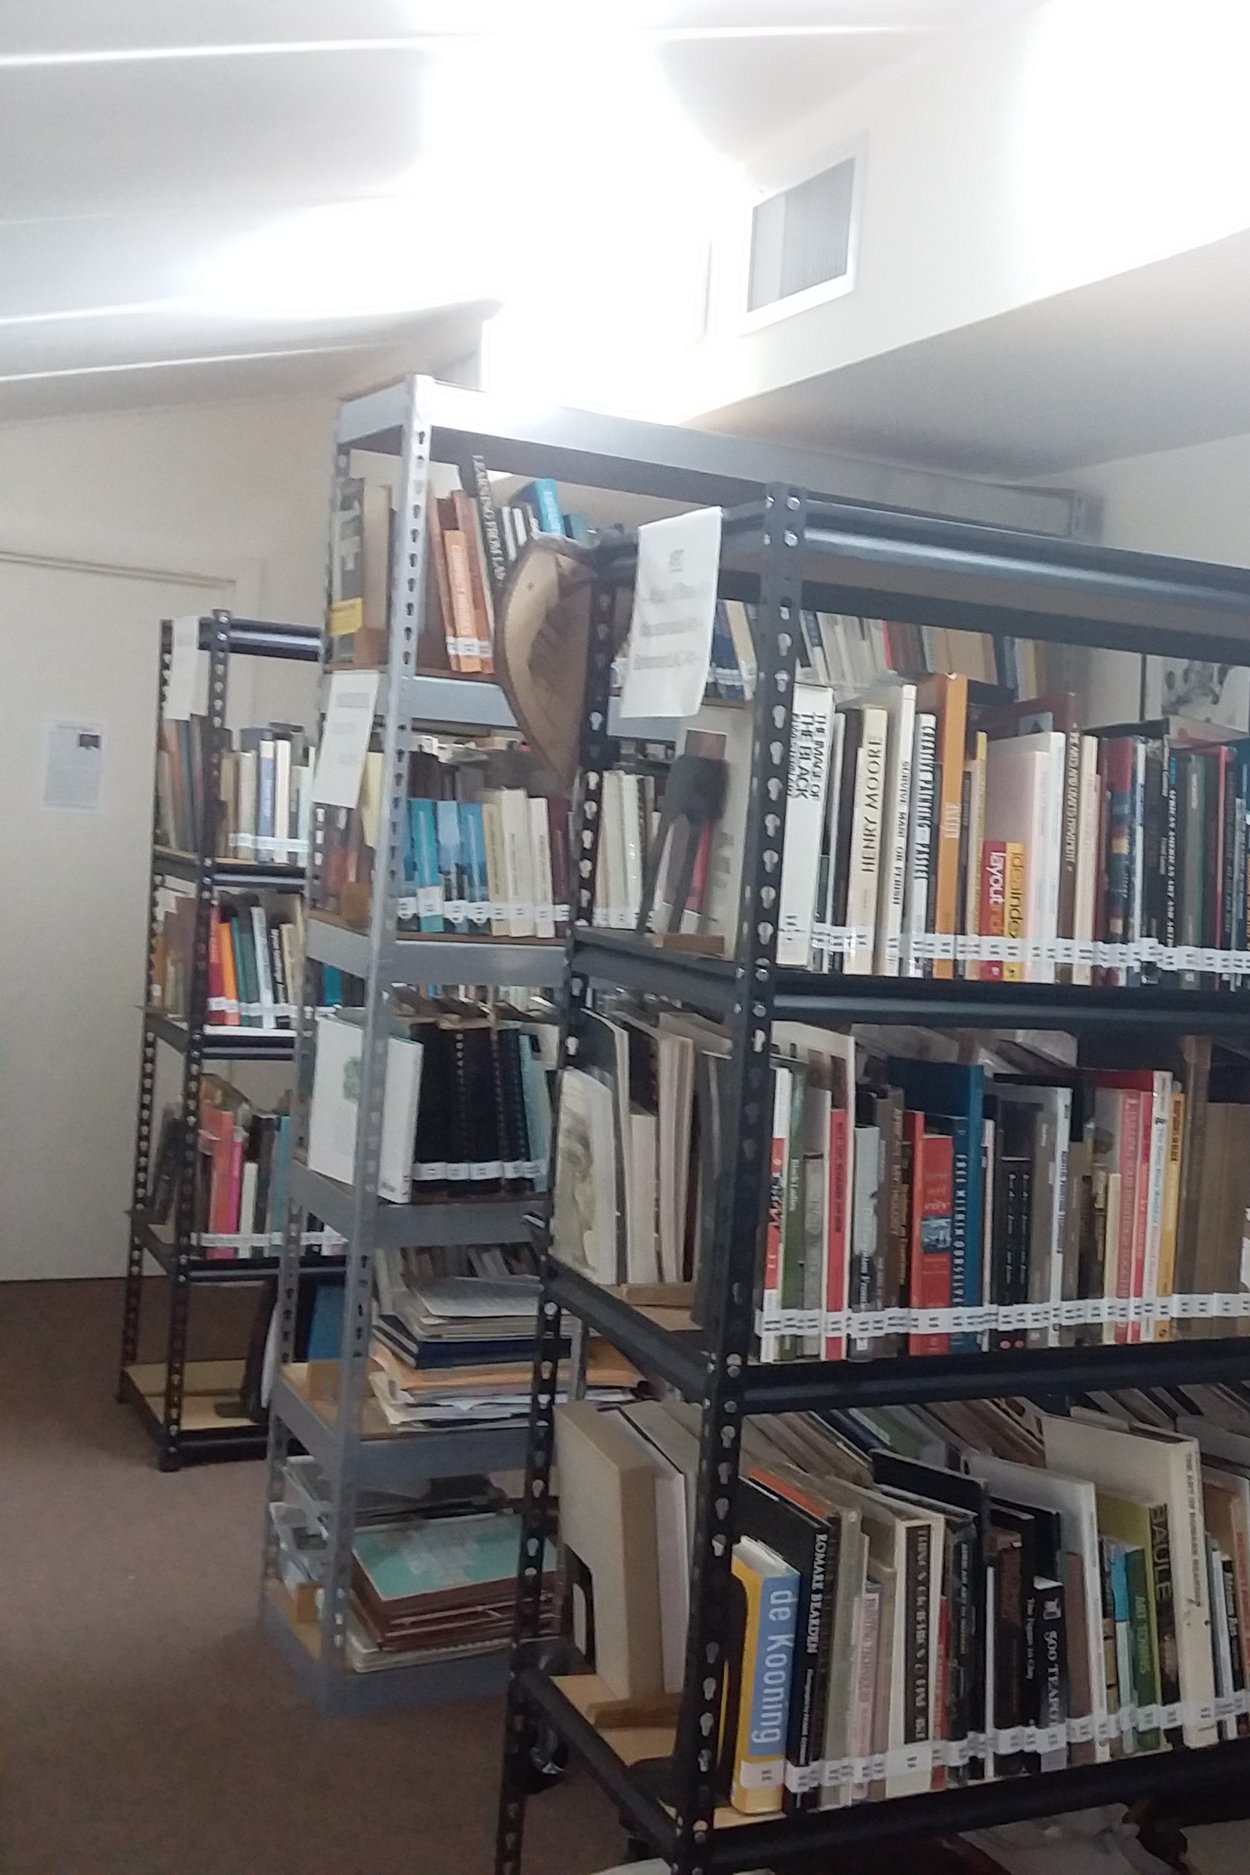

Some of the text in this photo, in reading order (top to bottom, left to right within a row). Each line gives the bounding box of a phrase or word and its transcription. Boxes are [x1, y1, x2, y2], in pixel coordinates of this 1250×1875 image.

[793, 746, 811, 800] BLACK
[918, 725, 936, 773] CREATIVE
[916, 778, 934, 829] PAINTING
[861, 816, 878, 873] HENRY
[789, 1159, 800, 1182] Black
[805, 1533, 829, 1654] ROMARE BEARDEN
[751, 1590, 798, 1744] de Kooning
[1043, 1630, 1060, 1661] 500
